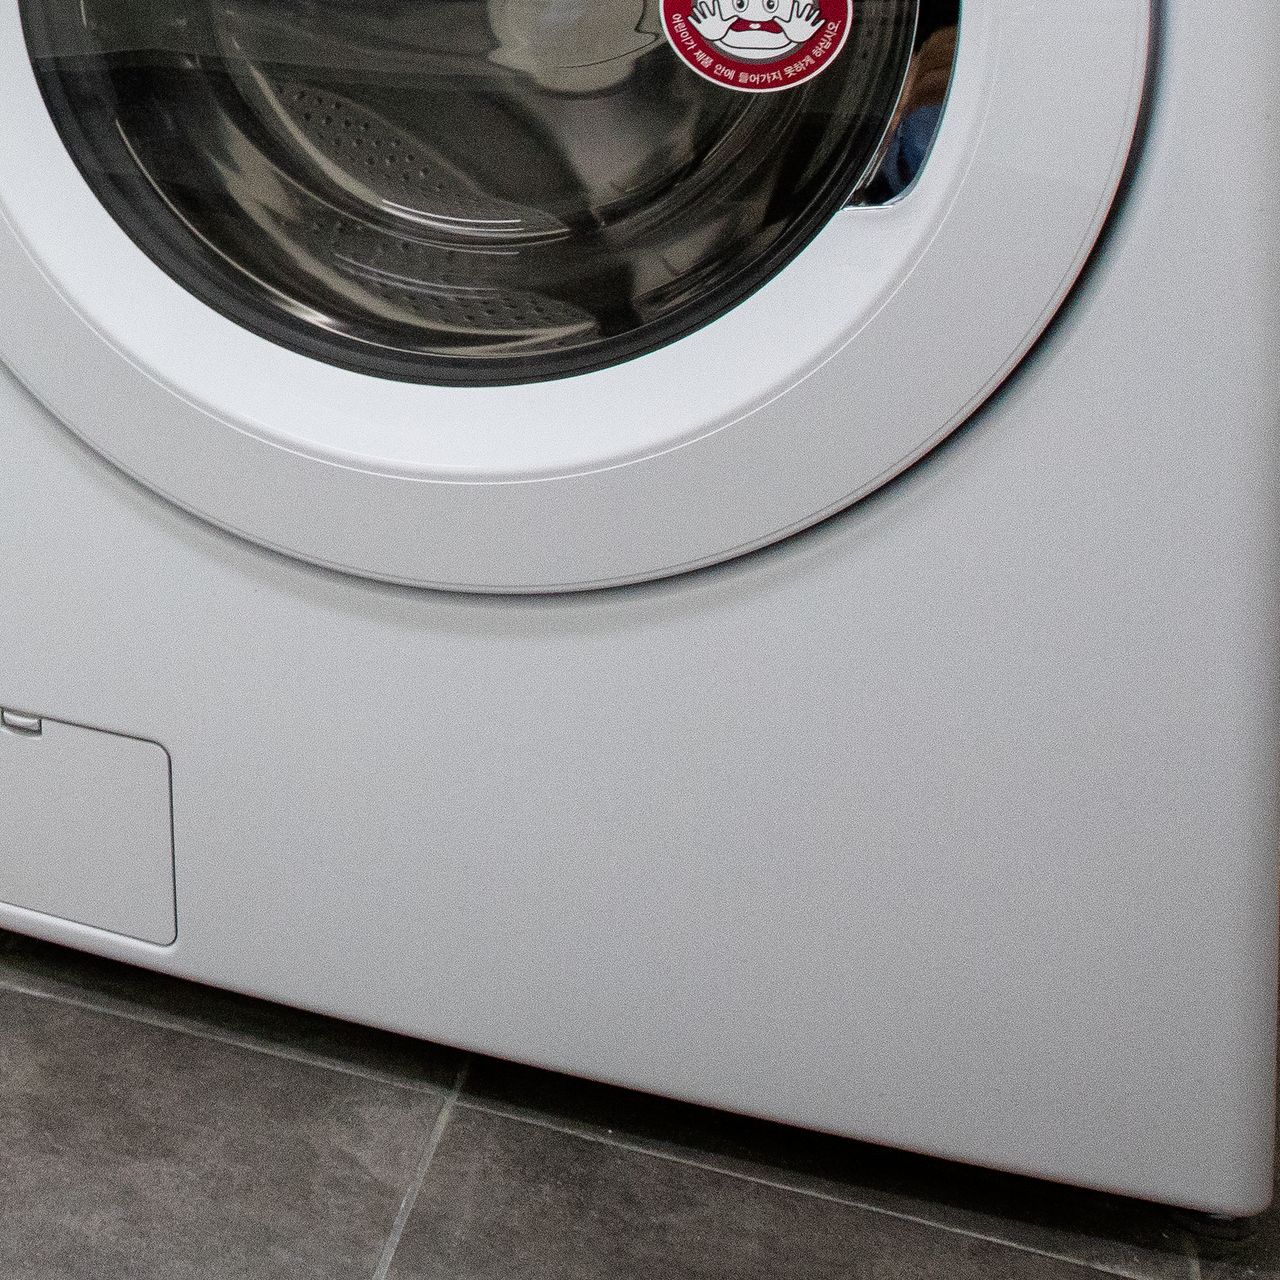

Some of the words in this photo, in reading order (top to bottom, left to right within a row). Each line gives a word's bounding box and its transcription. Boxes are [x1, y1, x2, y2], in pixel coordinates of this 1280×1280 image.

[671, 13, 696, 52] 어린이가
[693, 51, 715, 69] 제품
[713, 63, 735, 81] 안에
[738, 71, 783, 85] 들어가지
[784, 55, 816, 79] 못하게
